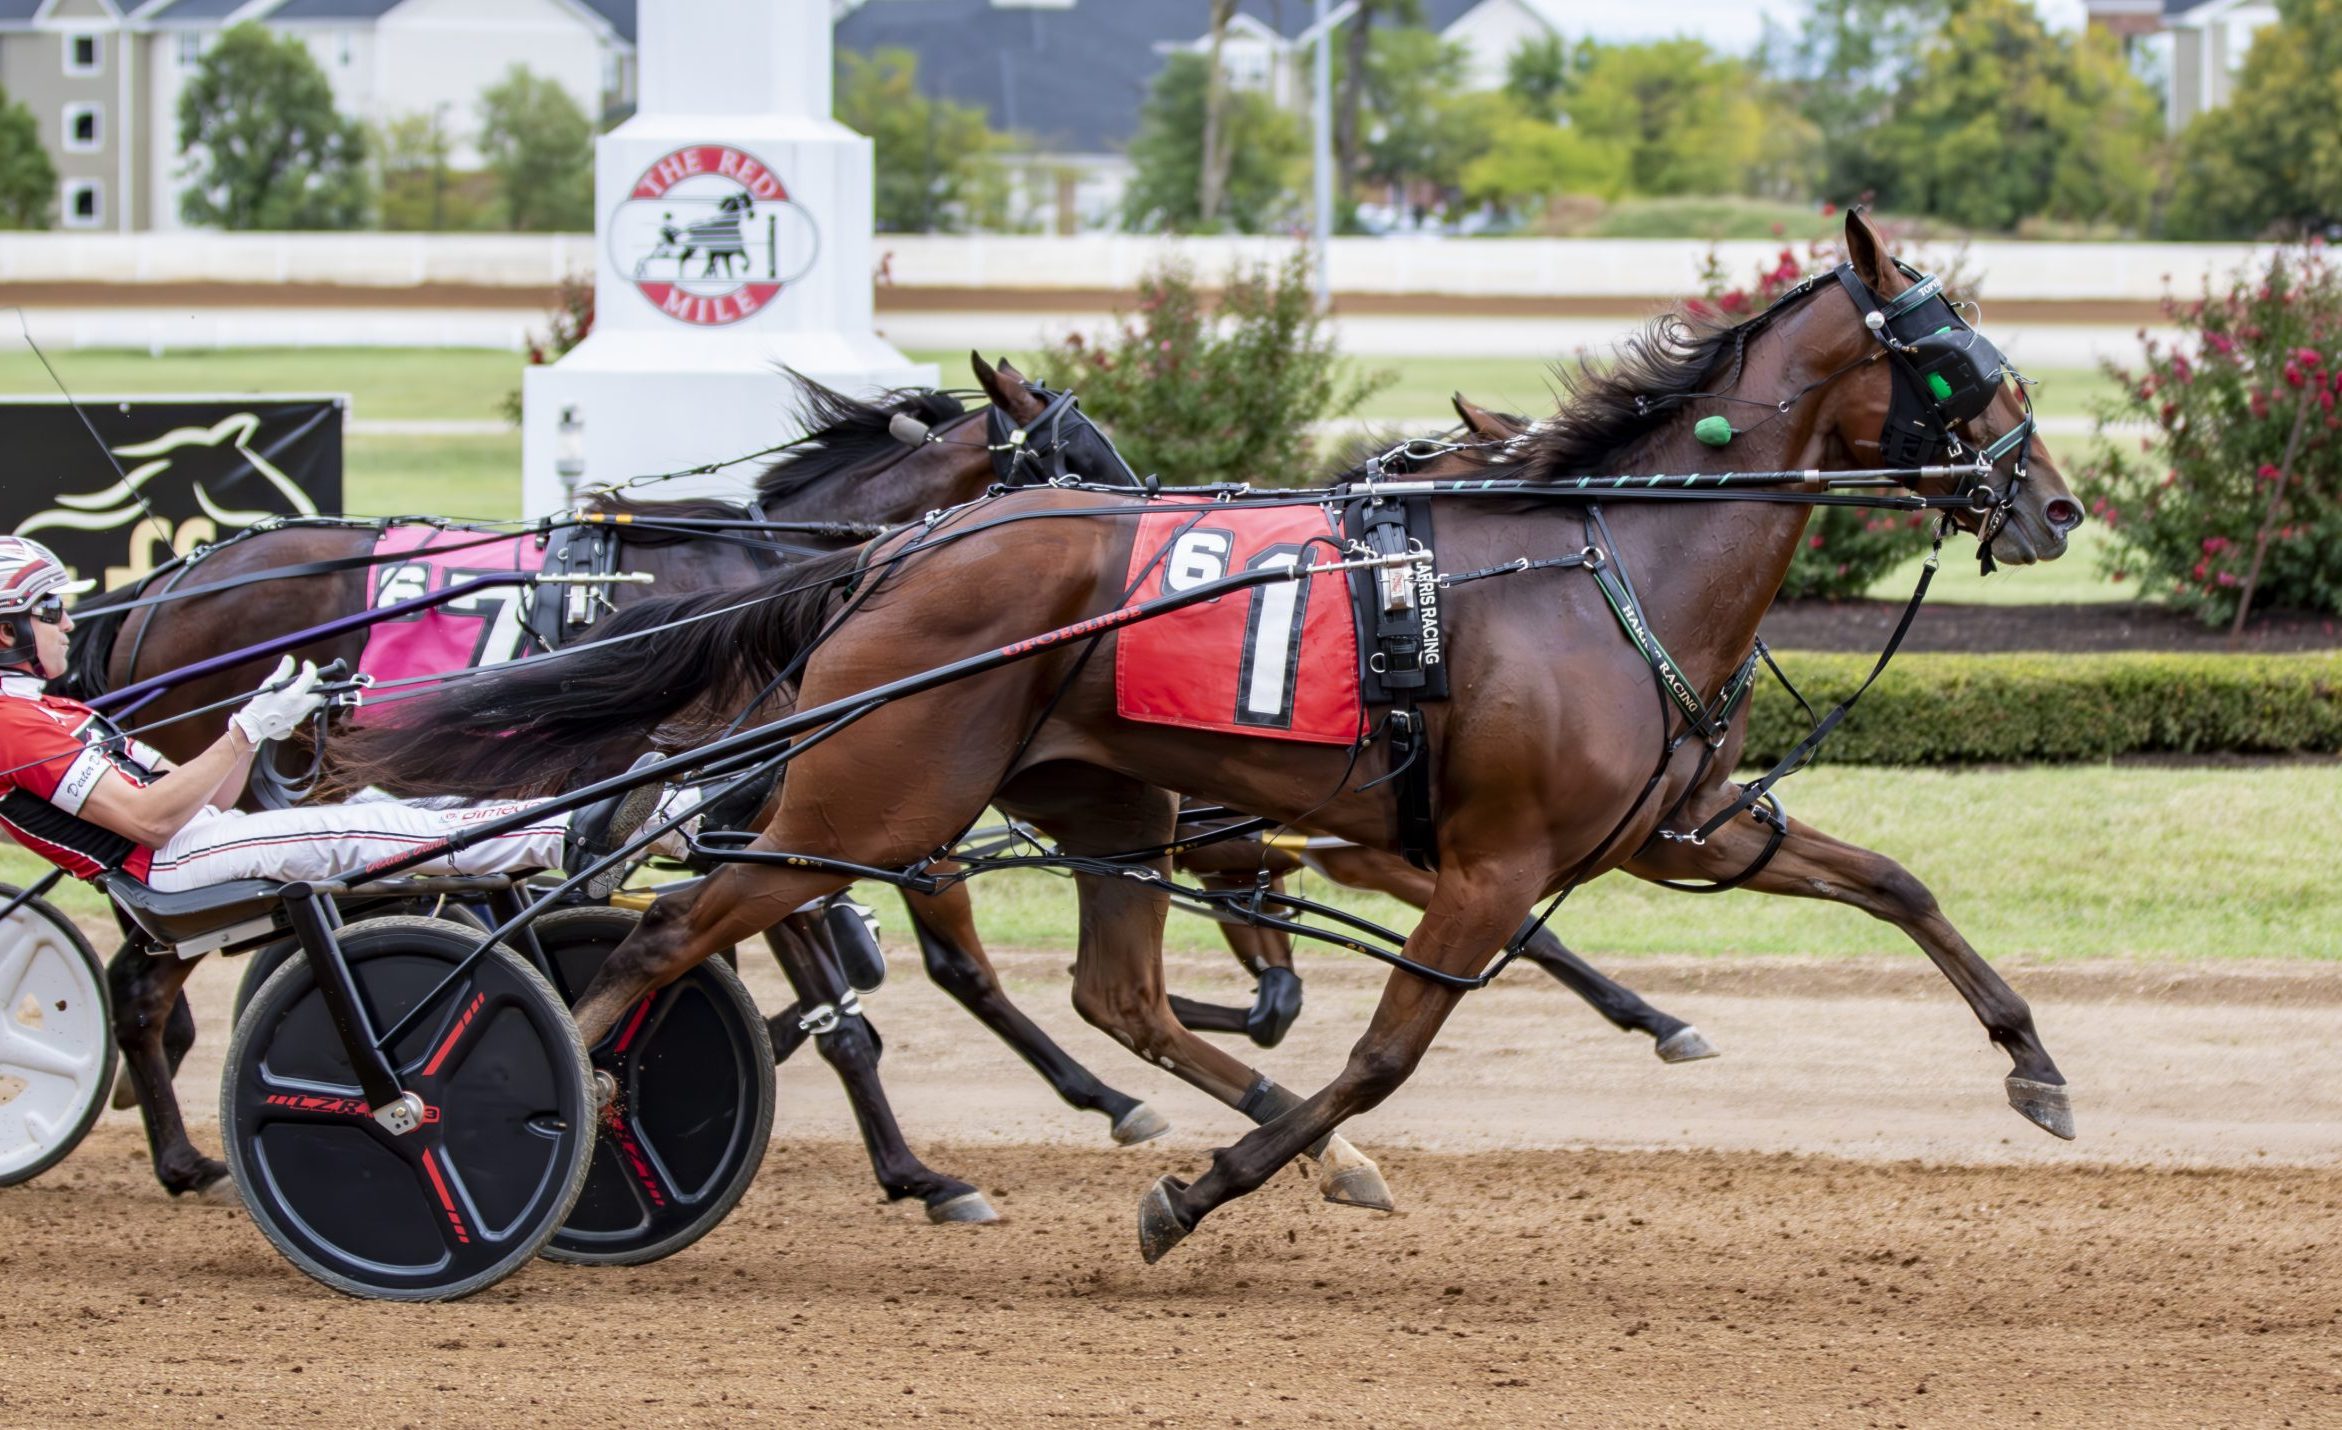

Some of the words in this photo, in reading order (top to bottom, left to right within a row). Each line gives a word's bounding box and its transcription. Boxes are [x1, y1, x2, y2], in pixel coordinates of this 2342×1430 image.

[641, 149, 703, 195] THE
[718, 149, 778, 197] RED
[662, 289, 757, 321] MILE
[1416, 562, 1436, 606] ARRIS
[374, 565, 427, 616] 6
[447, 573, 535, 667] 7
[1167, 531, 1228, 600] 6
[1248, 550, 1301, 715] 1
[1420, 606, 1440, 666] RACING
[66, 766, 95, 798] Dexter
